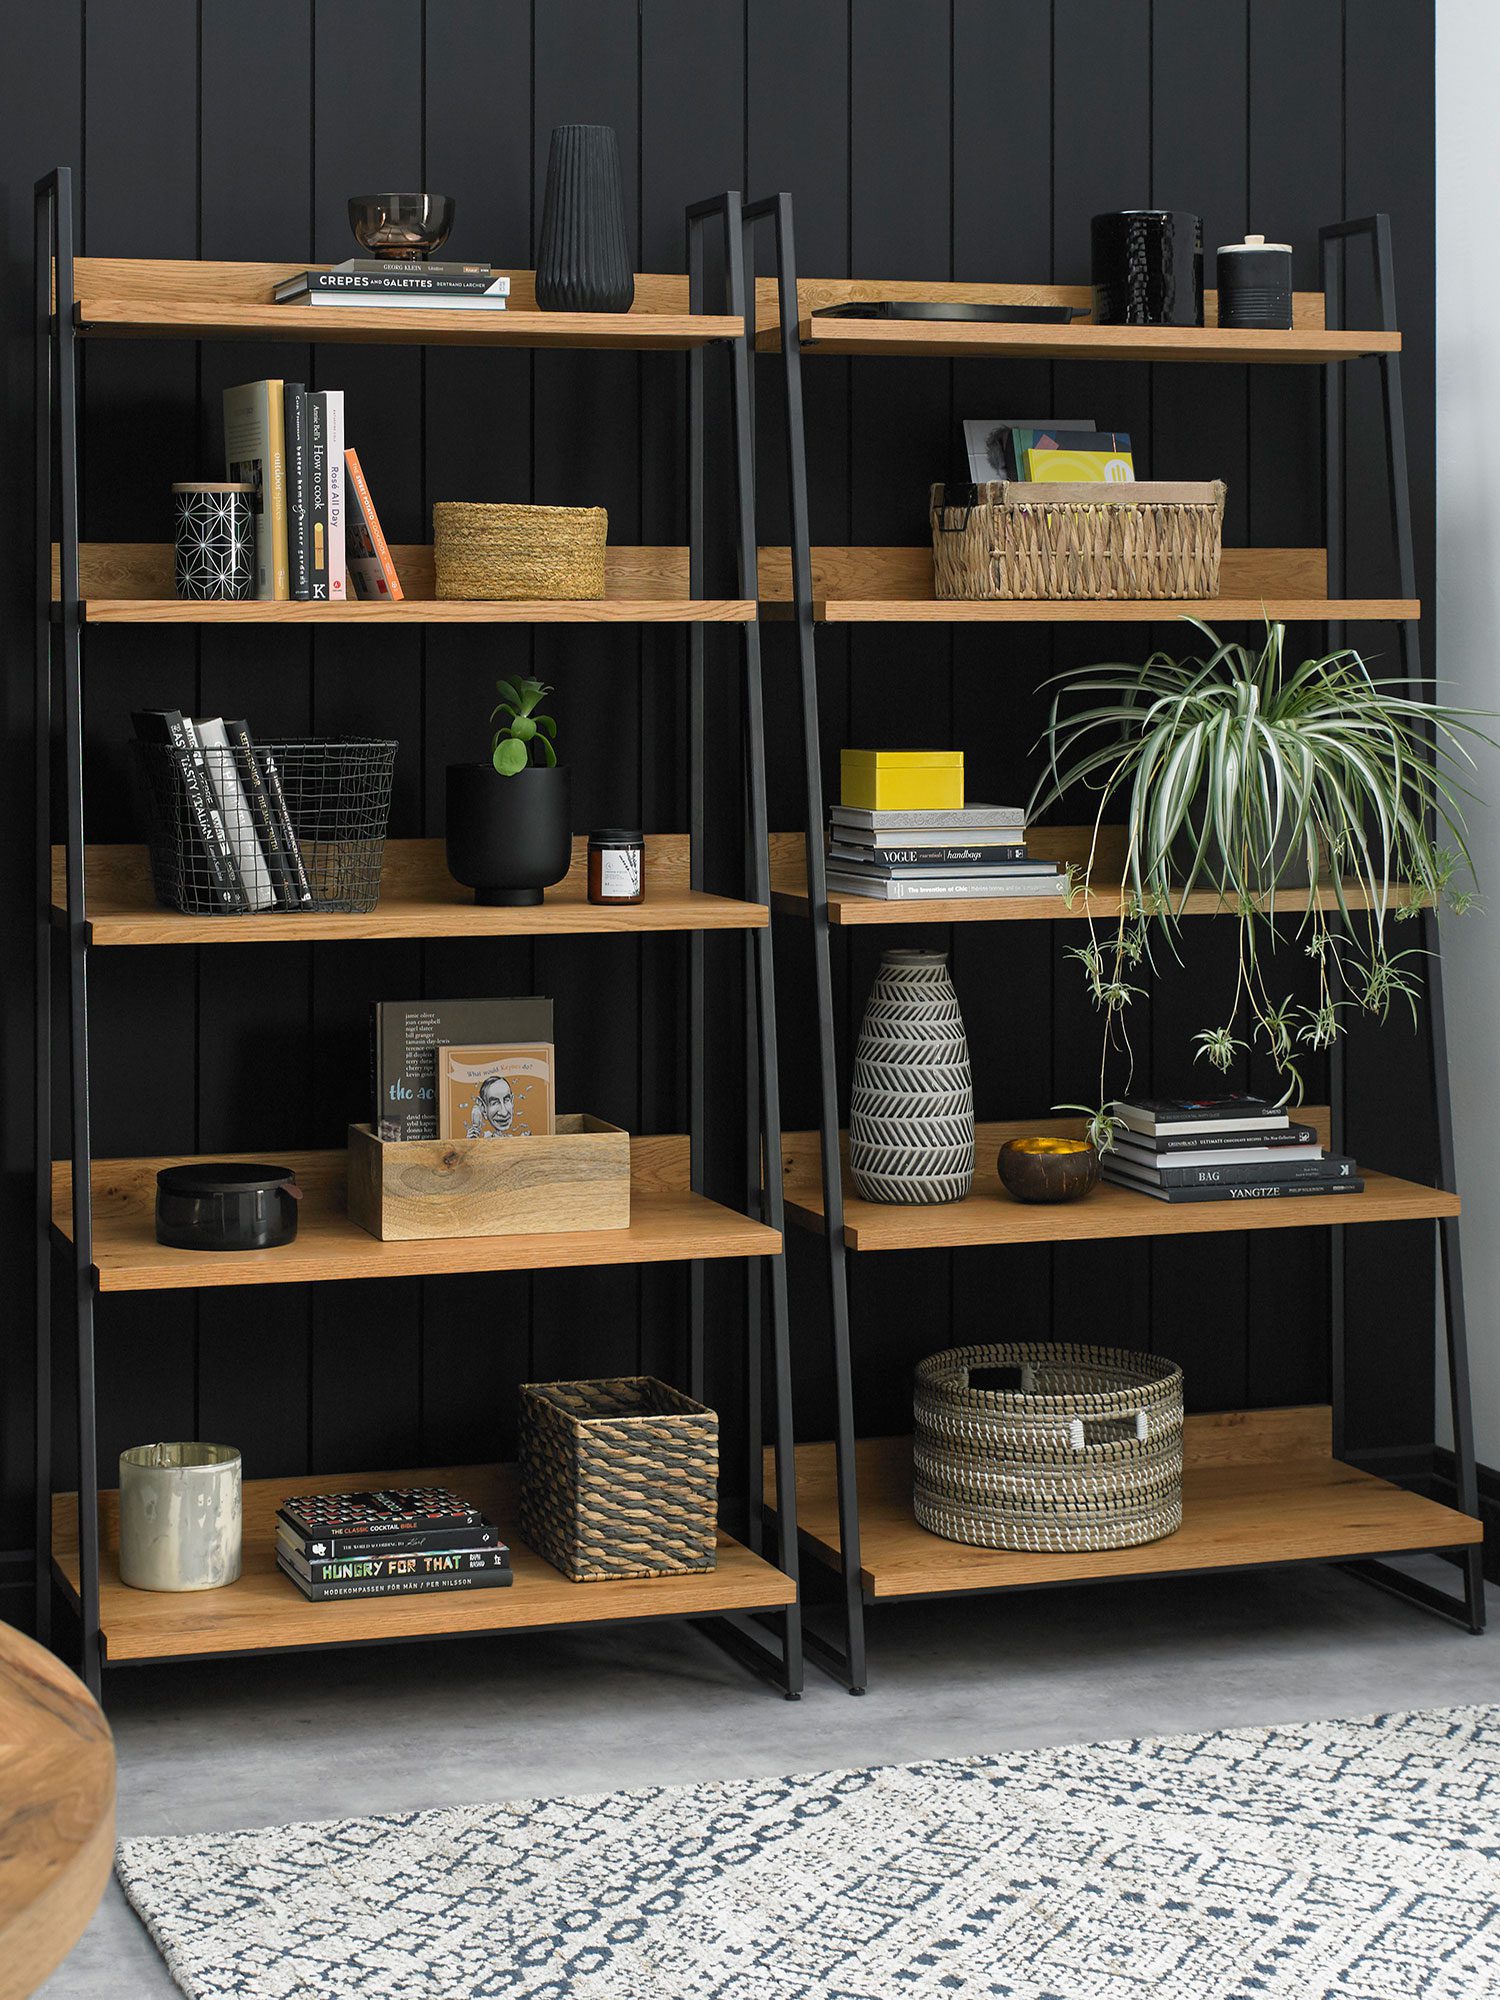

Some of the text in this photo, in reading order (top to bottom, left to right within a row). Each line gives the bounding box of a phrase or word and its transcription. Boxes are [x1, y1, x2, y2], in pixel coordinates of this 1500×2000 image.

[320, 276, 369, 287] CREPES
[383, 278, 433, 288] GALETTES
[314, 445, 324, 470] How
[314, 472, 323, 482] to
[274, 452, 285, 520] outdoor spaces
[314, 485, 325, 510] cook
[330, 509, 339, 528] Day
[356, 475, 366, 496] SWEET
[364, 496, 374, 520] POTATO
[371, 520, 386, 556] COOKBOOK
[313, 584, 326, 598] K
[883, 851, 918, 862] VOGUE
[947, 850, 982, 861] handbags
[389, 1078, 413, 1100] the
[1199, 1172, 1220, 1182] BAG
[1230, 1187, 1280, 1198] YANGTZE
[322, 1561, 383, 1580] HUNGRY
[388, 1559, 416, 1575] FOR
[424, 1556, 461, 1571] THAT
[324, 1586, 384, 1595] MODEKOMPASSEN
